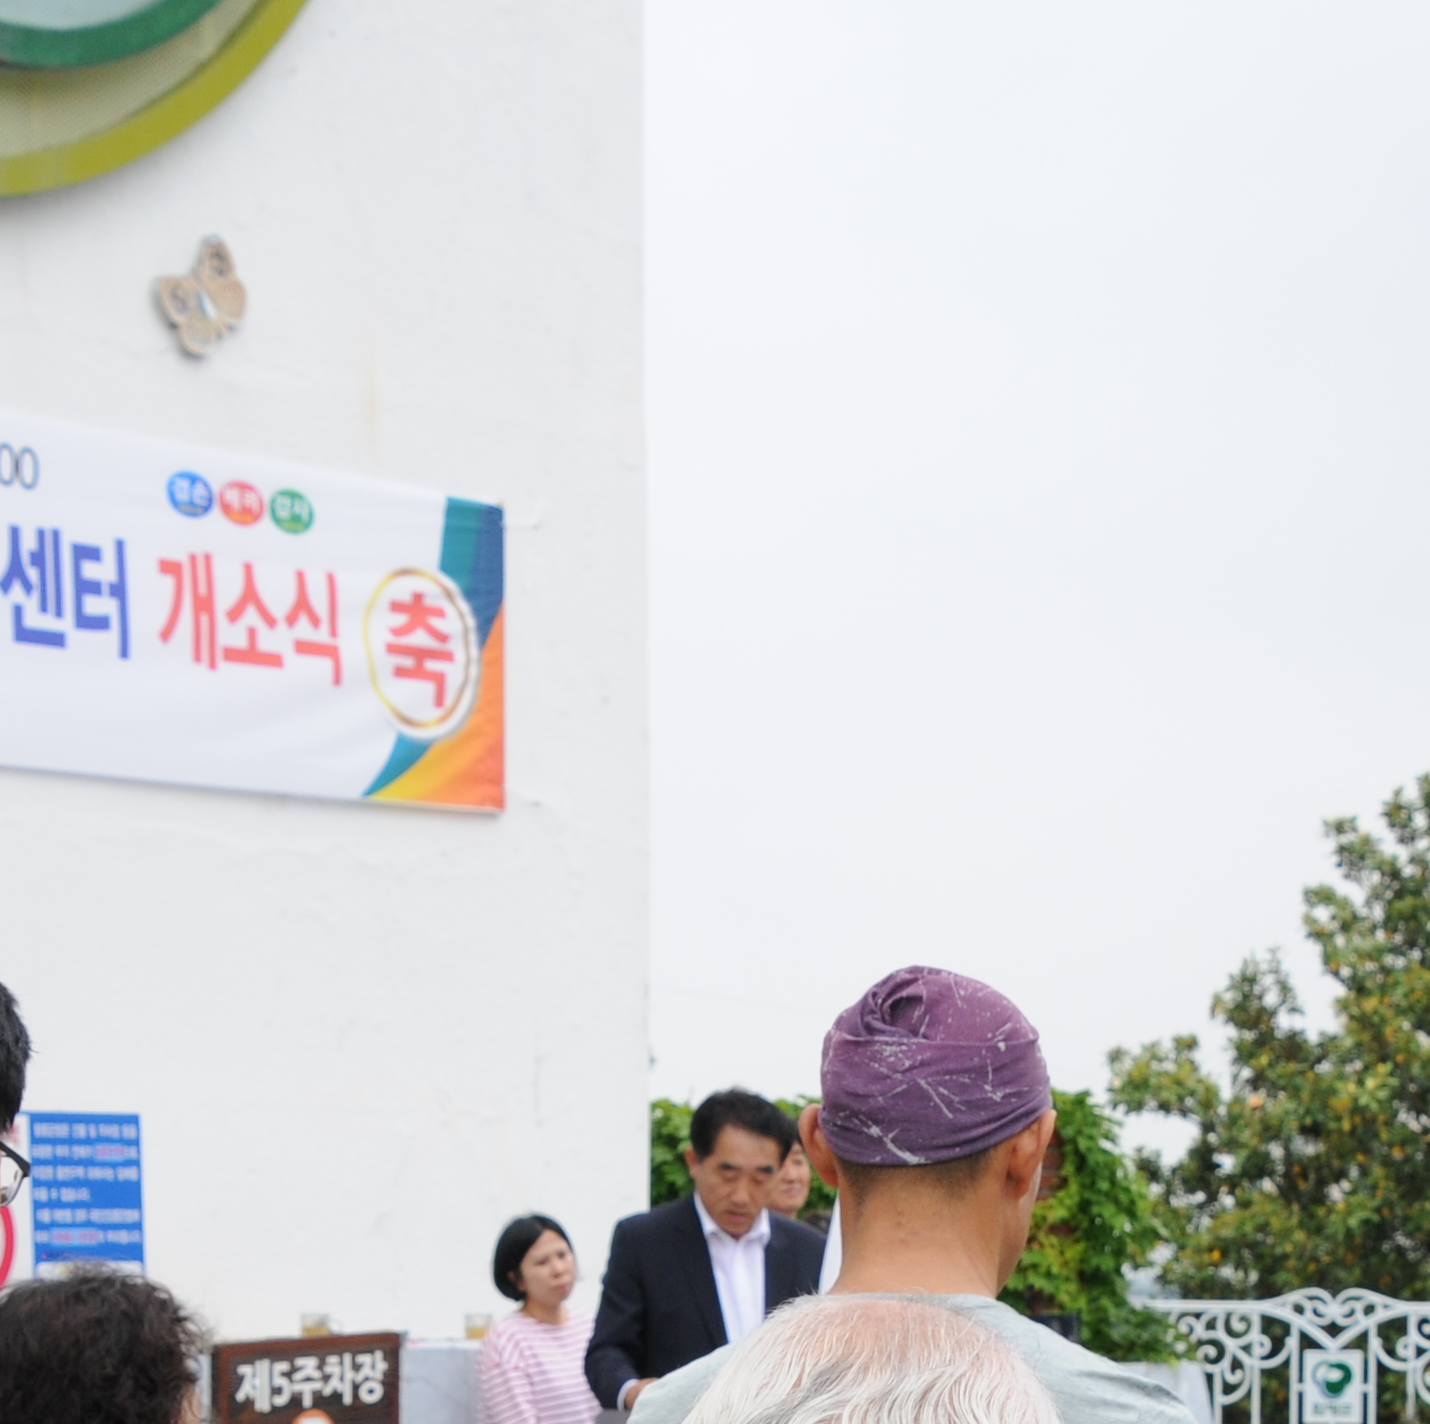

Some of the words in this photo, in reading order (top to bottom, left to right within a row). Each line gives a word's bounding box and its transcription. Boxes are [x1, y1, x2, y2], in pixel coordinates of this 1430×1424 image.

[158, 552, 343, 687] 개소식
[385, 591, 456, 709] 축
[235, 1350, 389, 1414] 제5주차장
